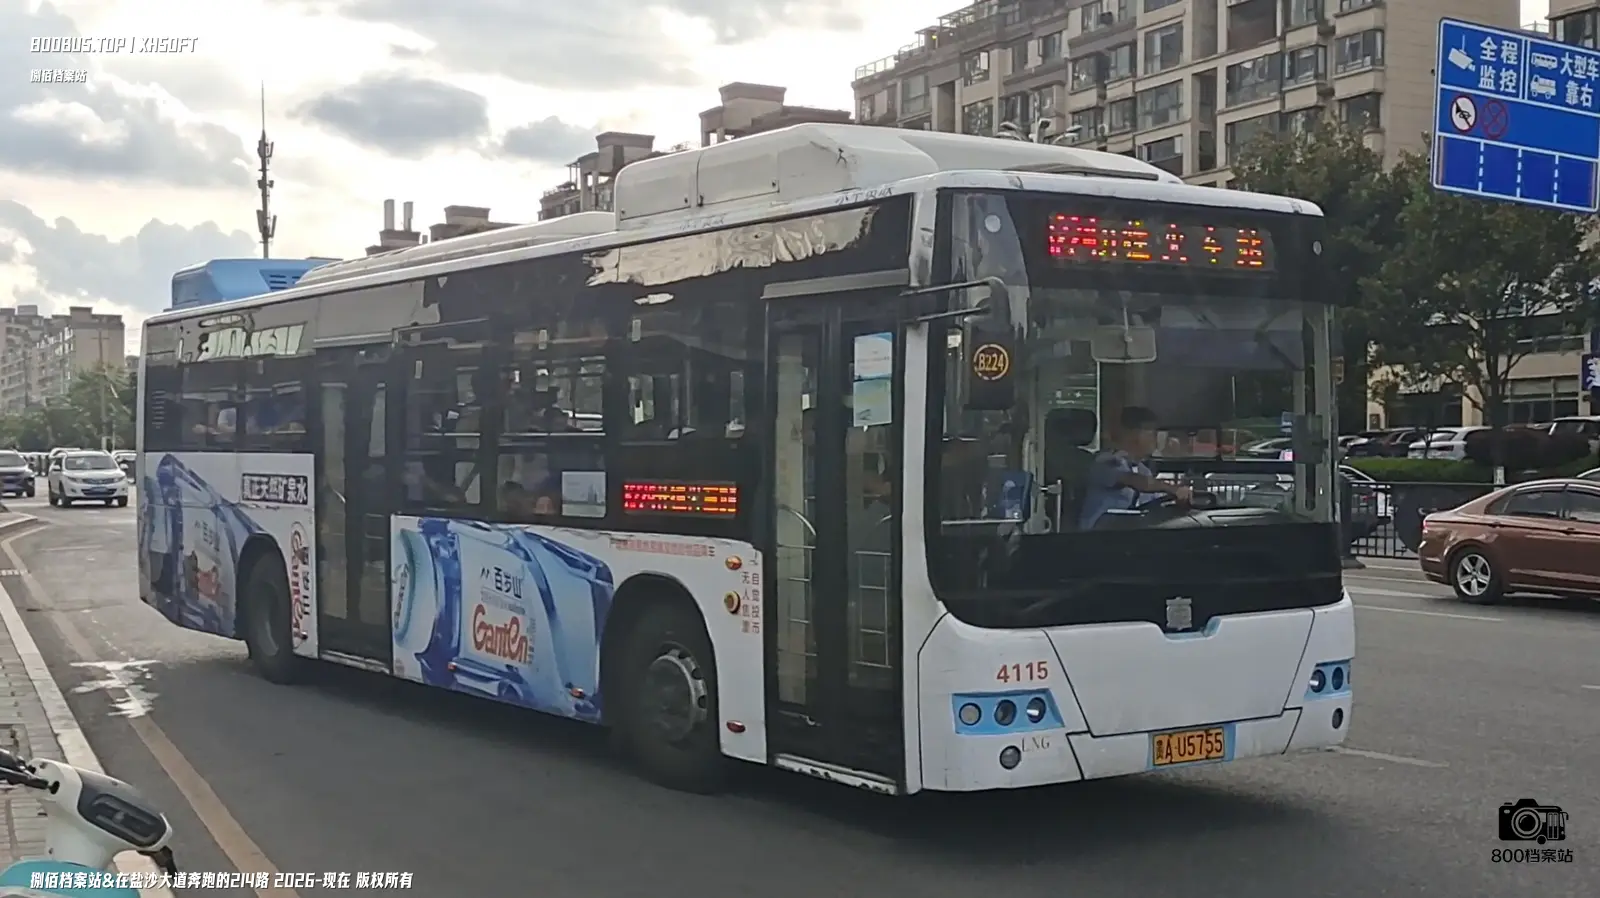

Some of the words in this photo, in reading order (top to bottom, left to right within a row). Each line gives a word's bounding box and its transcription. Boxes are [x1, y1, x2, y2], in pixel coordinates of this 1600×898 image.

[1479, 36, 1518, 66] 全程
[1478, 65, 1517, 94] 监控
[1560, 52, 1599, 82] 大型车
[1565, 80, 1594, 108] 靠右
[977, 351, 1004, 371] B224
[473, 603, 528, 665] Ganten
[996, 661, 1048, 683] 4115
[1021, 736, 1051, 753] LNG
